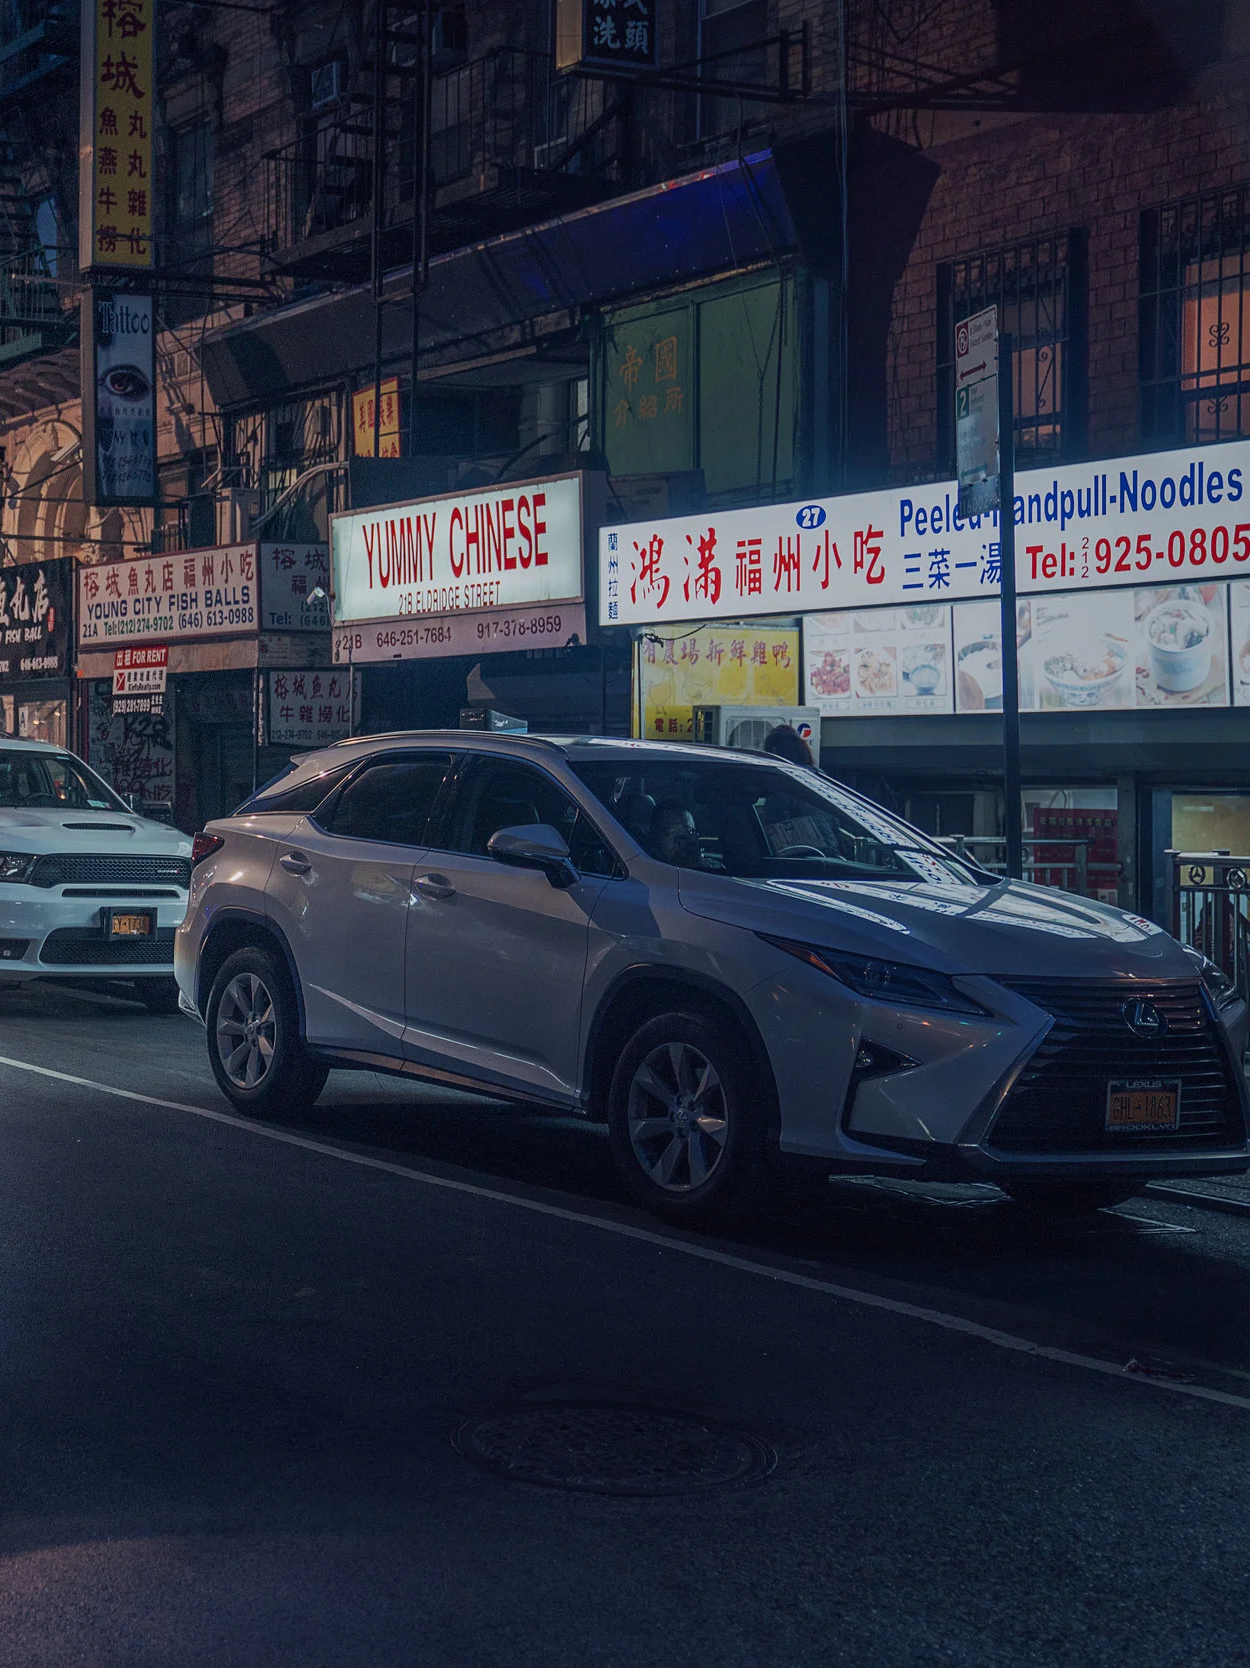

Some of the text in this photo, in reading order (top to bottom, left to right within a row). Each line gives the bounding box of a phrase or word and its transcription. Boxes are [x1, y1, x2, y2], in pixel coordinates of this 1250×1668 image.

[101, 0, 146, 98] 榕城
[592, 15, 649, 55] 洗頭
[100, 302, 150, 334] Tattoo
[620, 336, 677, 393] 帝國
[614, 386, 684, 429] 介紹所
[959, 390, 967, 418] 2
[801, 507, 821, 528] 27
[362, 493, 549, 589] YUMMY CHINESE
[1026, 523, 1250, 579] Tel: 212 925-0805
[83, 550, 254, 601] 榕城魚丸店 福州小吃
[272, 548, 329, 572] 榕城
[607, 532, 619, 620] 蘭州拉麵
[630, 524, 886, 609] 鴻滿福州小吃
[902, 542, 1001, 590] 三菜一湯
[87, 585, 250, 620] YOUNG CITY FISH BALLS
[399, 581, 501, 616] 21B ELDRIDGE STREET
[5, 628, 21, 645] FISH
[24, 625, 42, 642] BALL
[82, 623, 98, 638] 21A
[178, 611, 203, 630] (646)
[207, 607, 254, 627] 613-0988
[269, 612, 292, 625] Tel:
[343, 634, 362, 650] 21B
[377, 626, 452, 648] 646-251-7684
[477, 615, 562, 640] 917-378-8959
[133, 651, 146, 665] FOR
[147, 648, 167, 663] RENT
[280, 705, 350, 723] 牛雜撈化
[1126, 1080, 1162, 1089] LEXUS
